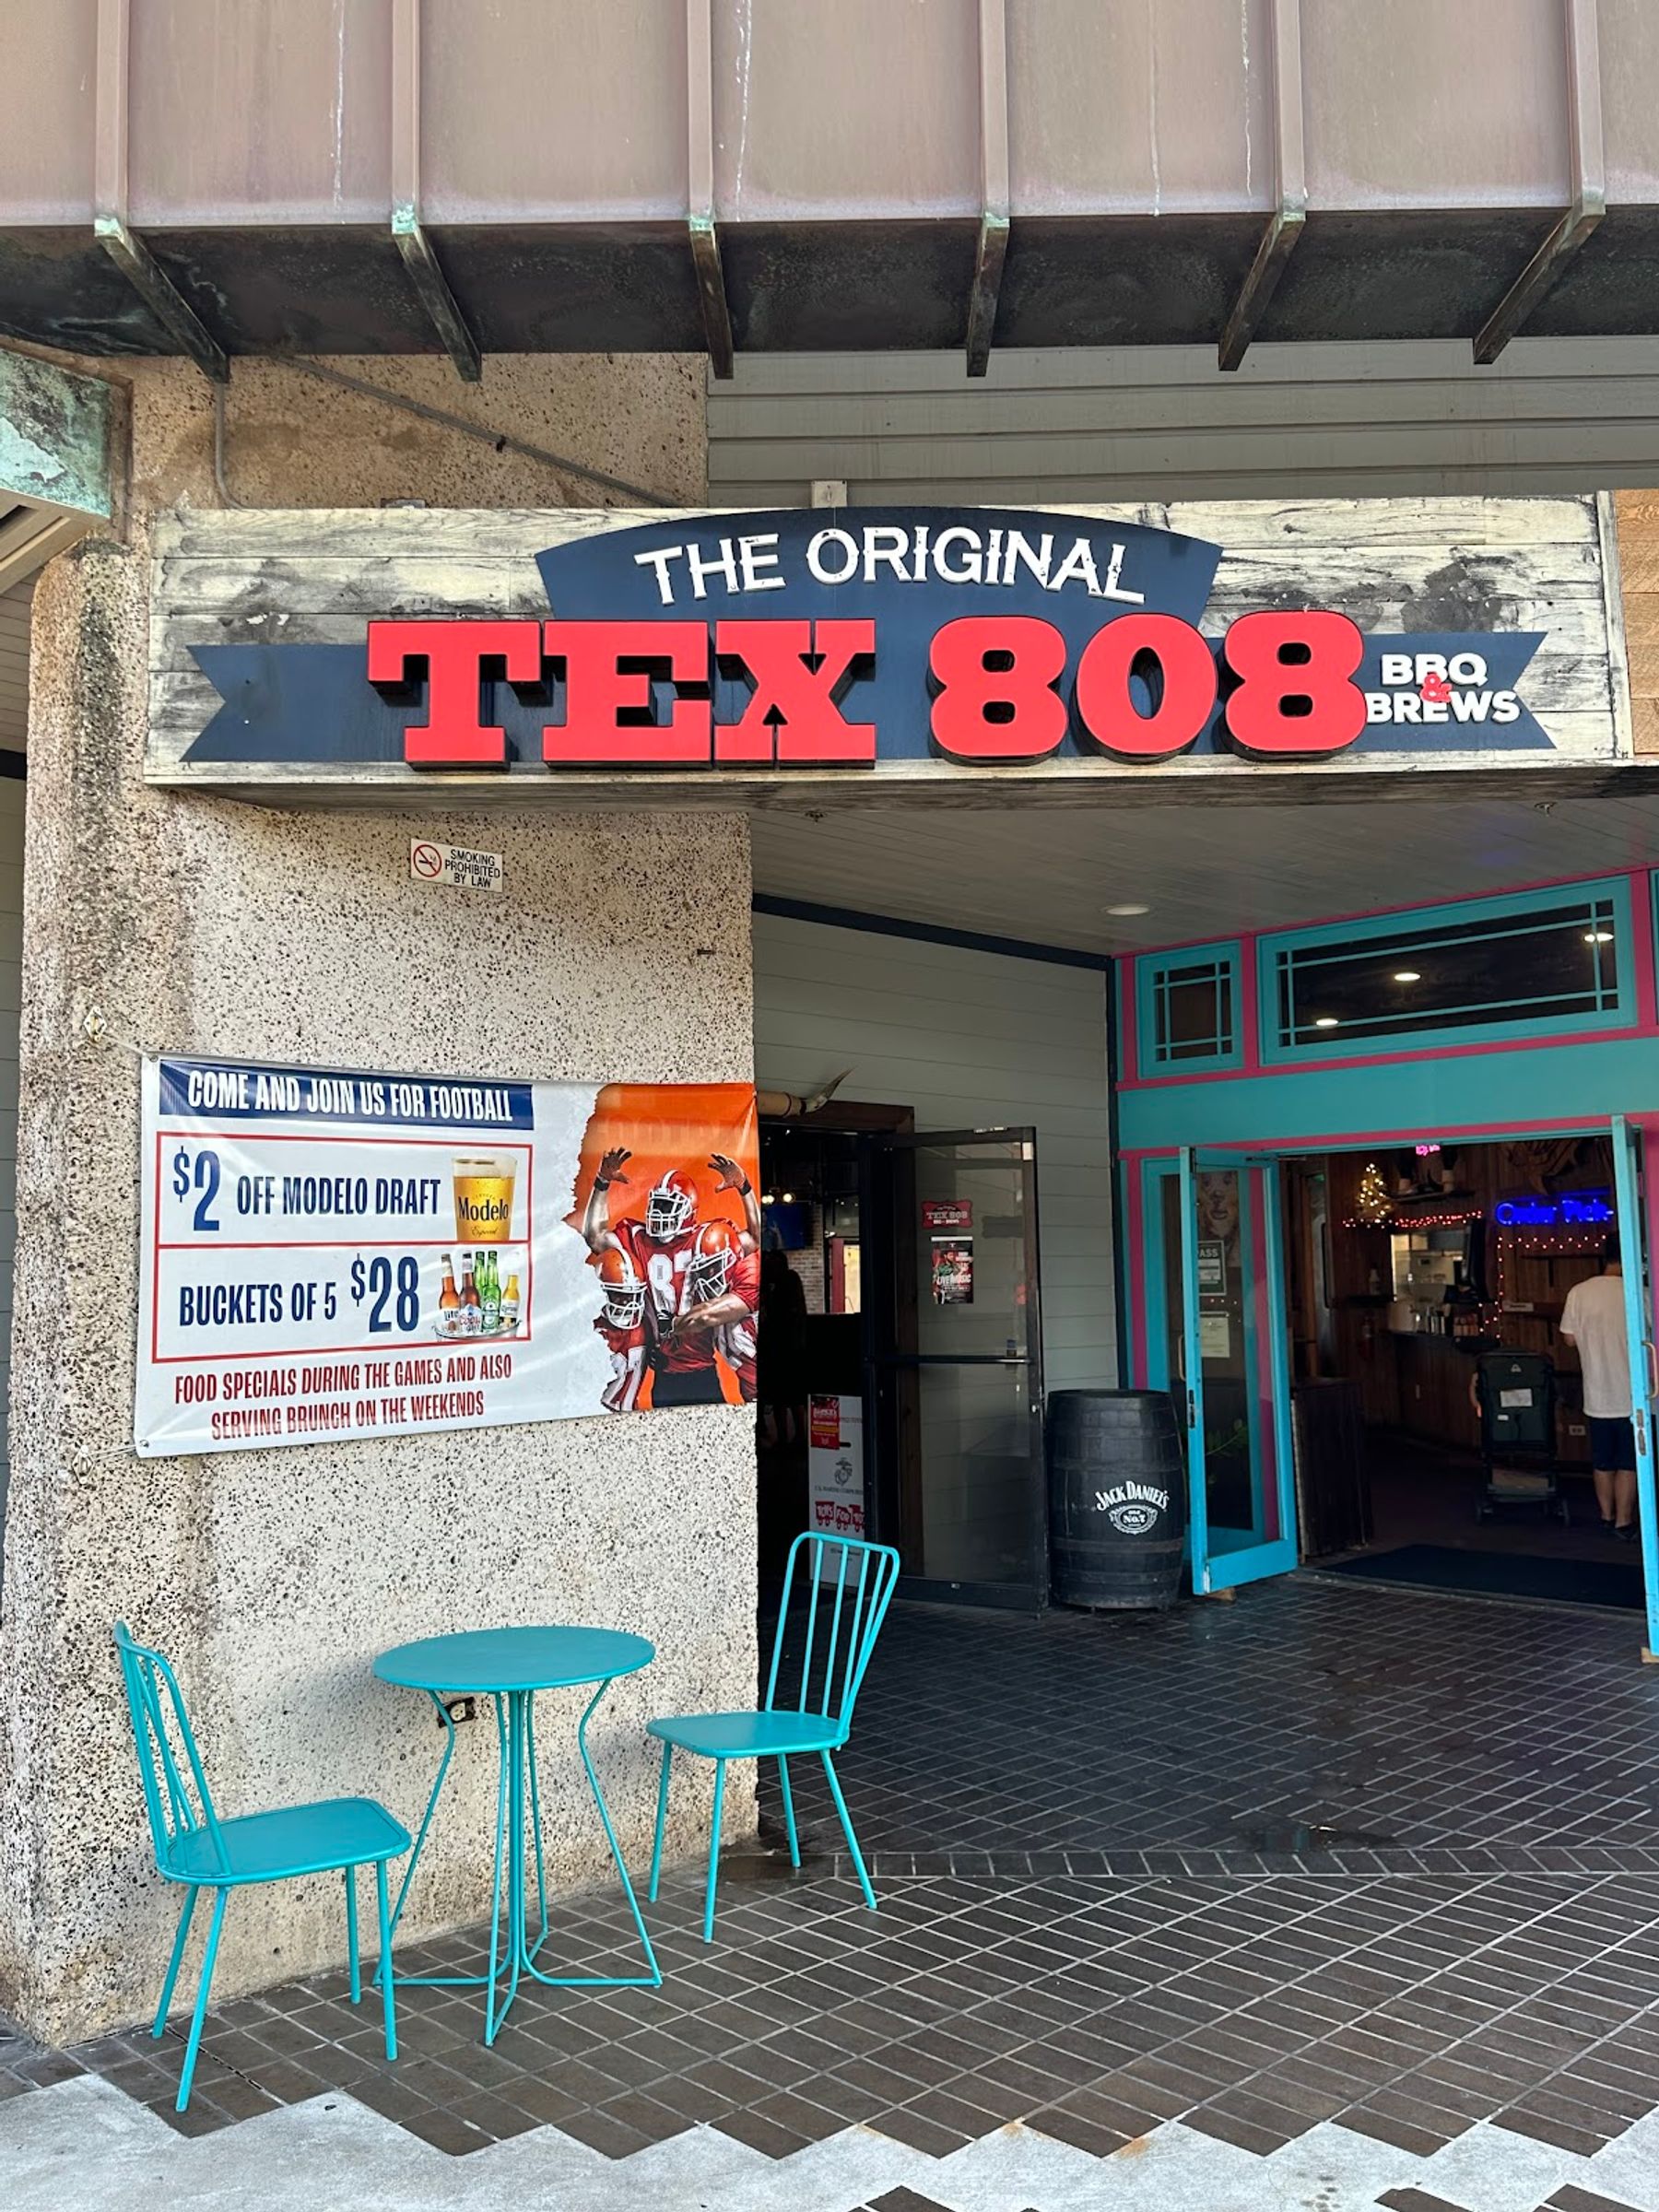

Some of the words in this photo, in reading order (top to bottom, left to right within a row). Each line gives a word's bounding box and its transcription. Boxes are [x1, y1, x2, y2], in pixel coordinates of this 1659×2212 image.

[633, 533, 786, 605] THE
[806, 526, 1145, 605] ORIGINAL
[1381, 653, 1488, 687] BBQ
[369, 619, 876, 765] TEX
[929, 611, 1368, 759] 808
[1420, 674, 1453, 702] &
[1365, 690, 1521, 724] BREWS
[445, 859, 500, 878] PROHIBITED
[451, 849, 495, 866] SMOKING
[453, 872, 466, 884] BY
[471, 876, 492, 888] LAW
[188, 1070, 250, 1109] COME
[255, 1075, 300, 1112] AND
[307, 1077, 356, 1113] JOIN
[359, 1081, 385, 1116] US
[390, 1083, 425, 1118] FOR
[429, 1085, 513, 1122] FOOTBALL
[237, 1175, 276, 1215] OFF
[283, 1176, 368, 1216] MODELO
[375, 1178, 441, 1215] DRAFT
[458, 1196, 509, 1221] Modelo
[1197, 1249, 1218, 1258] ASS
[180, 1284, 283, 1326] BUCKETS
[291, 1282, 317, 1322] OF
[324, 1282, 336, 1320] 5
[351, 1253, 419, 1333] $28
[175, 1373, 218, 1404] FOOD
[222, 1368, 297, 1400] SPECIALS
[301, 1363, 359, 1394] DURING
[364, 1361, 390, 1389] THE
[394, 1358, 442, 1386] GAMES
[447, 1356, 476, 1382] AND
[480, 1353, 512, 1380] ALSO
[211, 1407, 282, 1441] SERVING
[287, 1401, 351, 1433] BRUNCH
[356, 1399, 376, 1428] ON
[381, 1397, 407, 1425] THE
[411, 1390, 484, 1422] WEEKENDS
[1095, 1486, 1126, 1511] JACK
